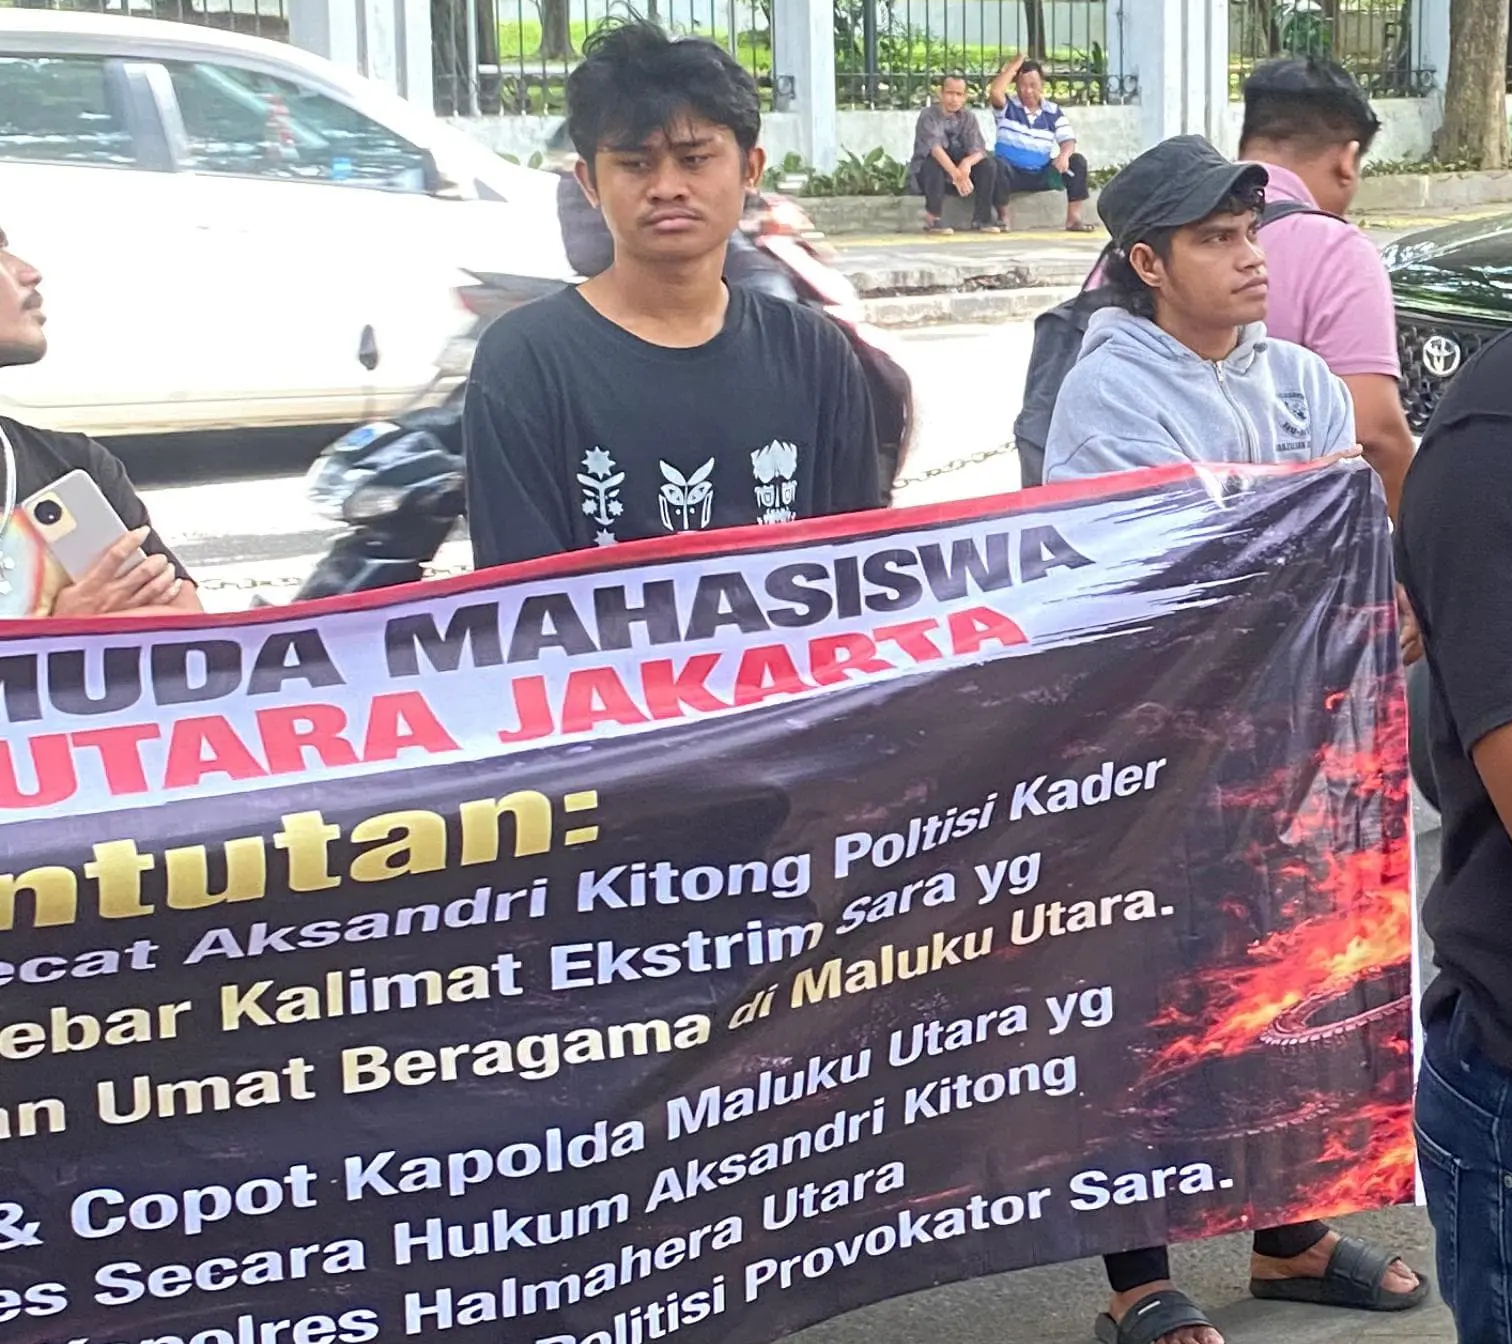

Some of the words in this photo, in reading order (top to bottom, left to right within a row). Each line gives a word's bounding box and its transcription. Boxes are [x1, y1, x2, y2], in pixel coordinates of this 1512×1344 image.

[384, 524, 1096, 678] MAHASISWA
[0, 691, 462, 807] UTARA
[497, 606, 1030, 743] JAKARTA
[0, 789, 599, 930] ntutan:
[0, 1001, 191, 1059] ebar
[220, 953, 523, 1031] Kalimat
[551, 919, 824, 991] Ekstrim
[974, 852, 1042, 905] yg
[183, 878, 549, 965] Aksandri
[577, 853, 811, 913] Kitong
[834, 793, 997, 880] Poltisi
[1009, 757, 1167, 821] Kader
[0, 1098, 66, 1139] n
[97, 1057, 316, 1125] Umat
[342, 1013, 711, 1094] Beragama
[728, 983, 779, 1029] di
[790, 926, 994, 1009] Maluku
[1010, 889, 1175, 946] Utara.
[0, 1202, 44, 1251] &
[70, 1164, 318, 1239] Copot
[345, 1120, 645, 1201] Kapolda
[666, 1048, 871, 1141] Maluku
[889, 1005, 1028, 1069] Utara
[1045, 985, 1113, 1036] yg
[94, 1238, 366, 1306] Secara
[394, 1193, 629, 1265] Hukum
[645, 1098, 884, 1213] Aksandri
[903, 1055, 1077, 1124] Kitong
[404, 1215, 743, 1335] Halmahera
[762, 1158, 905, 1232] Utara
[745, 1186, 1051, 1304] Provokator
[1068, 1161, 1234, 1210] Sara.
